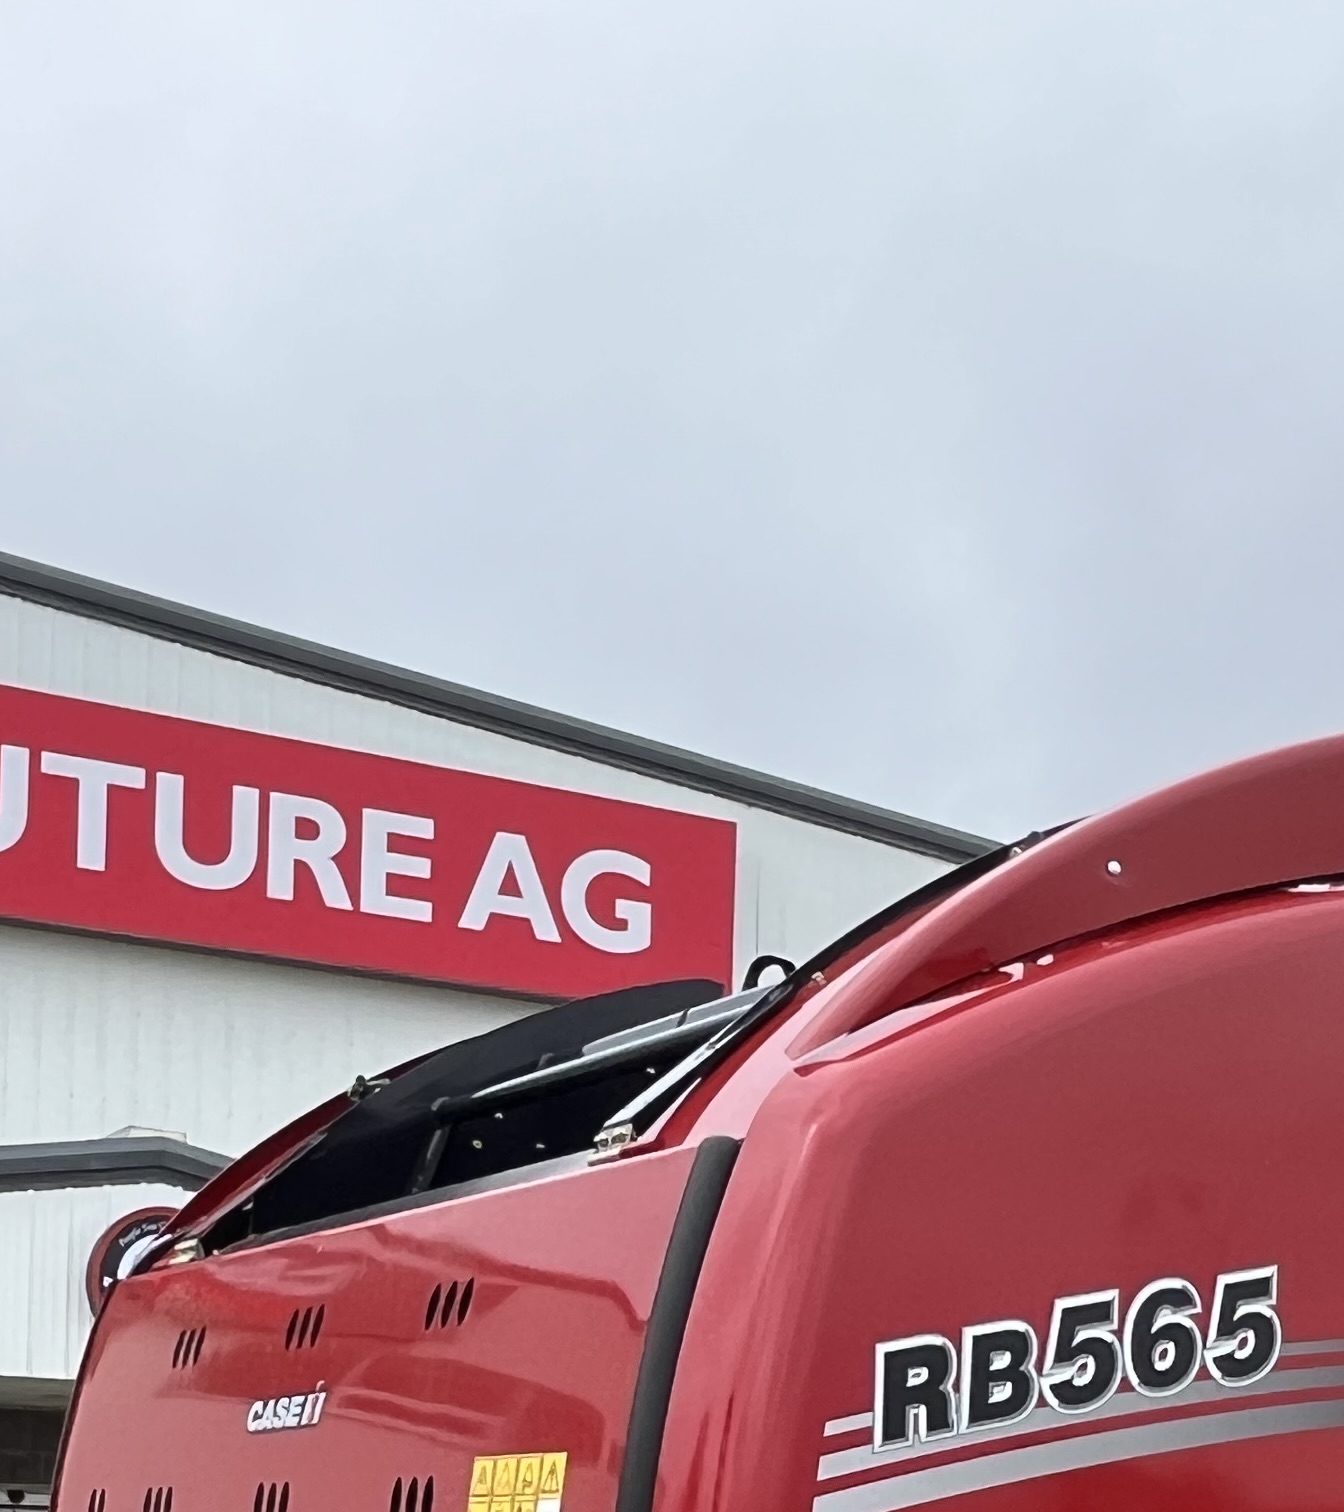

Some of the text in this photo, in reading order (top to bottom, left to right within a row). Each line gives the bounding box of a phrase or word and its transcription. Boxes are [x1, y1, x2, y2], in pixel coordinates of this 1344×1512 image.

[457, 831, 652, 954] AG
[247, 1395, 306, 1432] CASE
[872, 1264, 1283, 1454] RB565
